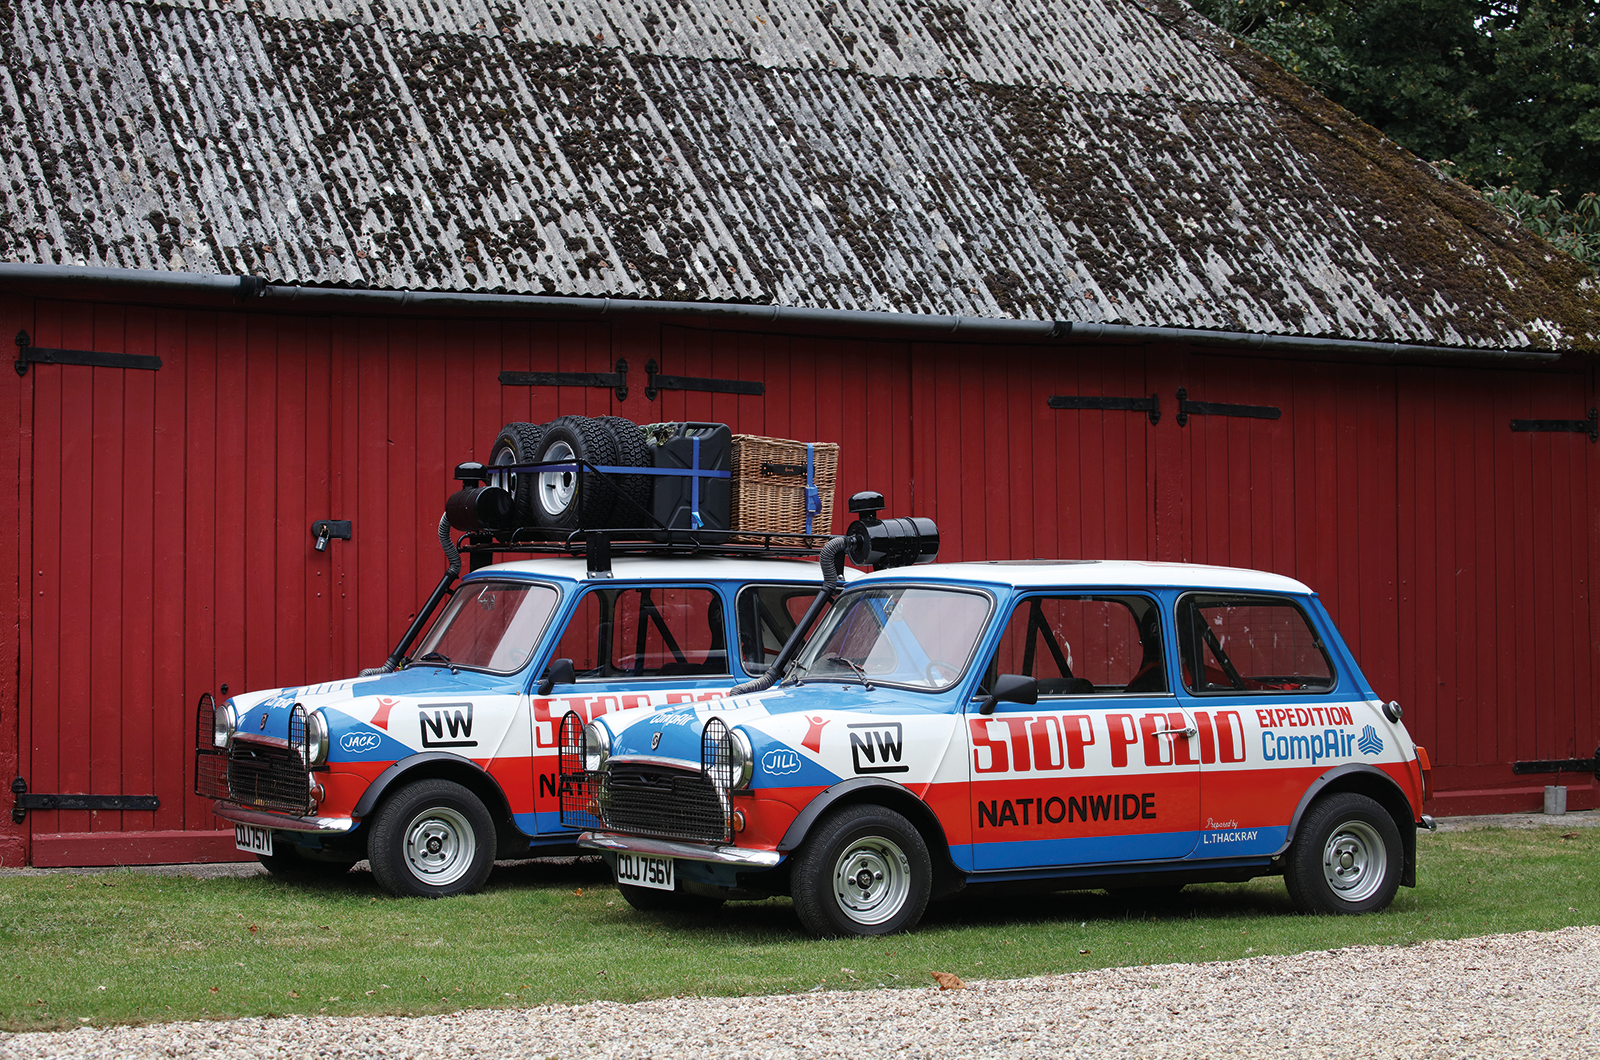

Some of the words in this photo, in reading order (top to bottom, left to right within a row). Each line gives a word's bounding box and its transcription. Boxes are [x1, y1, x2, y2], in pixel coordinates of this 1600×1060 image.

[418, 704, 475, 746] NW
[1255, 706, 1354, 728] EXPEDITION
[344, 736, 376, 748] JACK
[847, 724, 905, 771] NW
[969, 714, 1095, 774] STOP
[1105, 710, 1247, 768] POLIO
[1261, 729, 1356, 765] CompAir
[766, 754, 797, 769] JILL
[978, 793, 1157, 828] NATIONWIDE
[1205, 817, 1232, 830] Prepared
[1231, 819, 1239, 830] by
